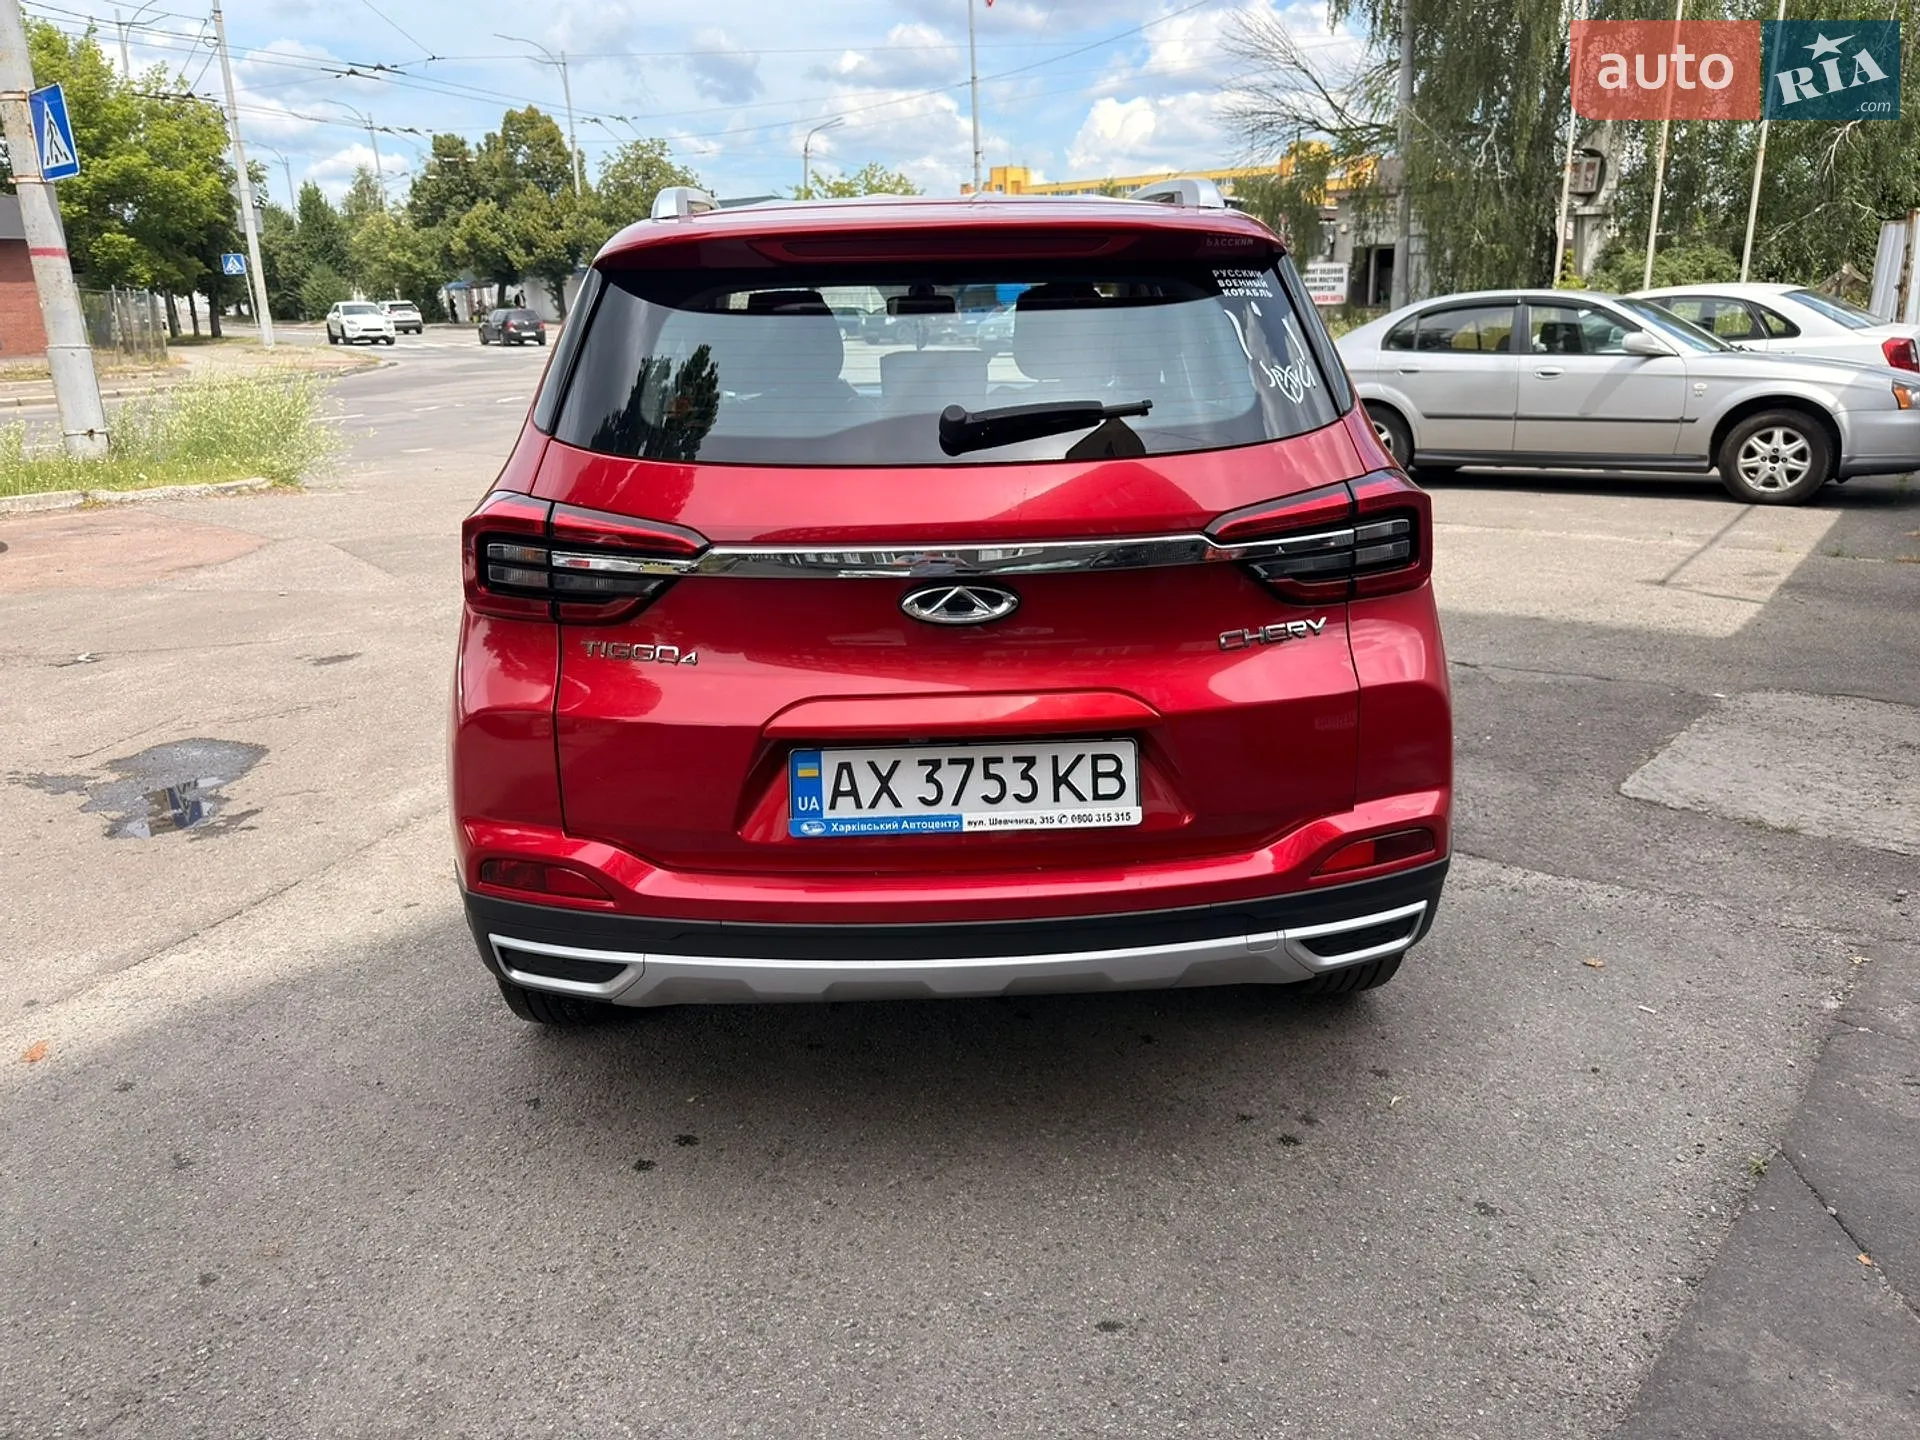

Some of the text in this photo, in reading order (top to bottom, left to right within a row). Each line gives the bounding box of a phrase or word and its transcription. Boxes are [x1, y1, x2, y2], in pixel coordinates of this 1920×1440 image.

[1217, 279, 1269, 289] ВОЕННЫЙ
[1222, 288, 1273, 298] КОРАБЛЬ
[1219, 616, 1327, 651] CHERY
[828, 753, 1127, 811] AX 3753 KB
[798, 796, 820, 812] UA
[831, 820, 899, 833] Харківський
[901, 819, 960, 831] Автоцентр
[1040, 815, 1055, 824] 315
[1095, 812, 1112, 822] 315
[1114, 811, 1132, 821] 315
